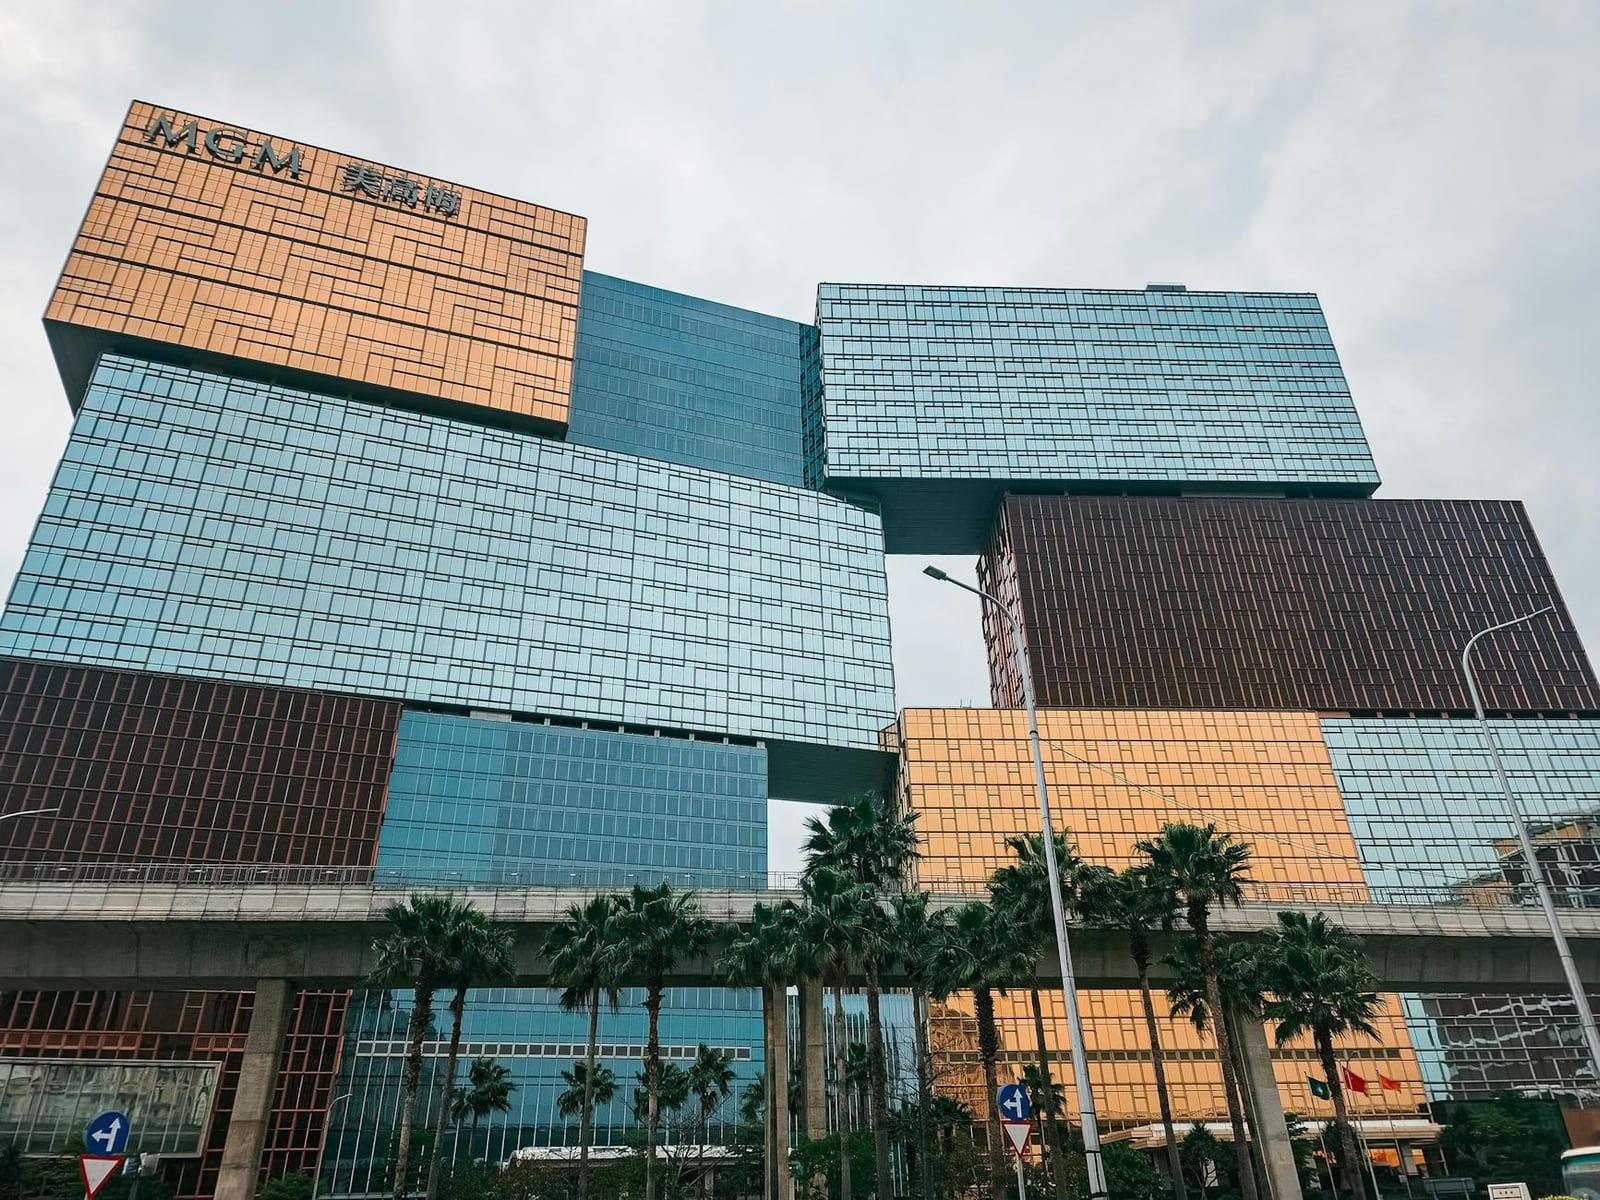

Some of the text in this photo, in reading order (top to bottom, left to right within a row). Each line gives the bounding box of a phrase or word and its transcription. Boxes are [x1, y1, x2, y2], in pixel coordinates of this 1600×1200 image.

[144, 112, 303, 180] MGM
[341, 162, 461, 217] 美高梅
